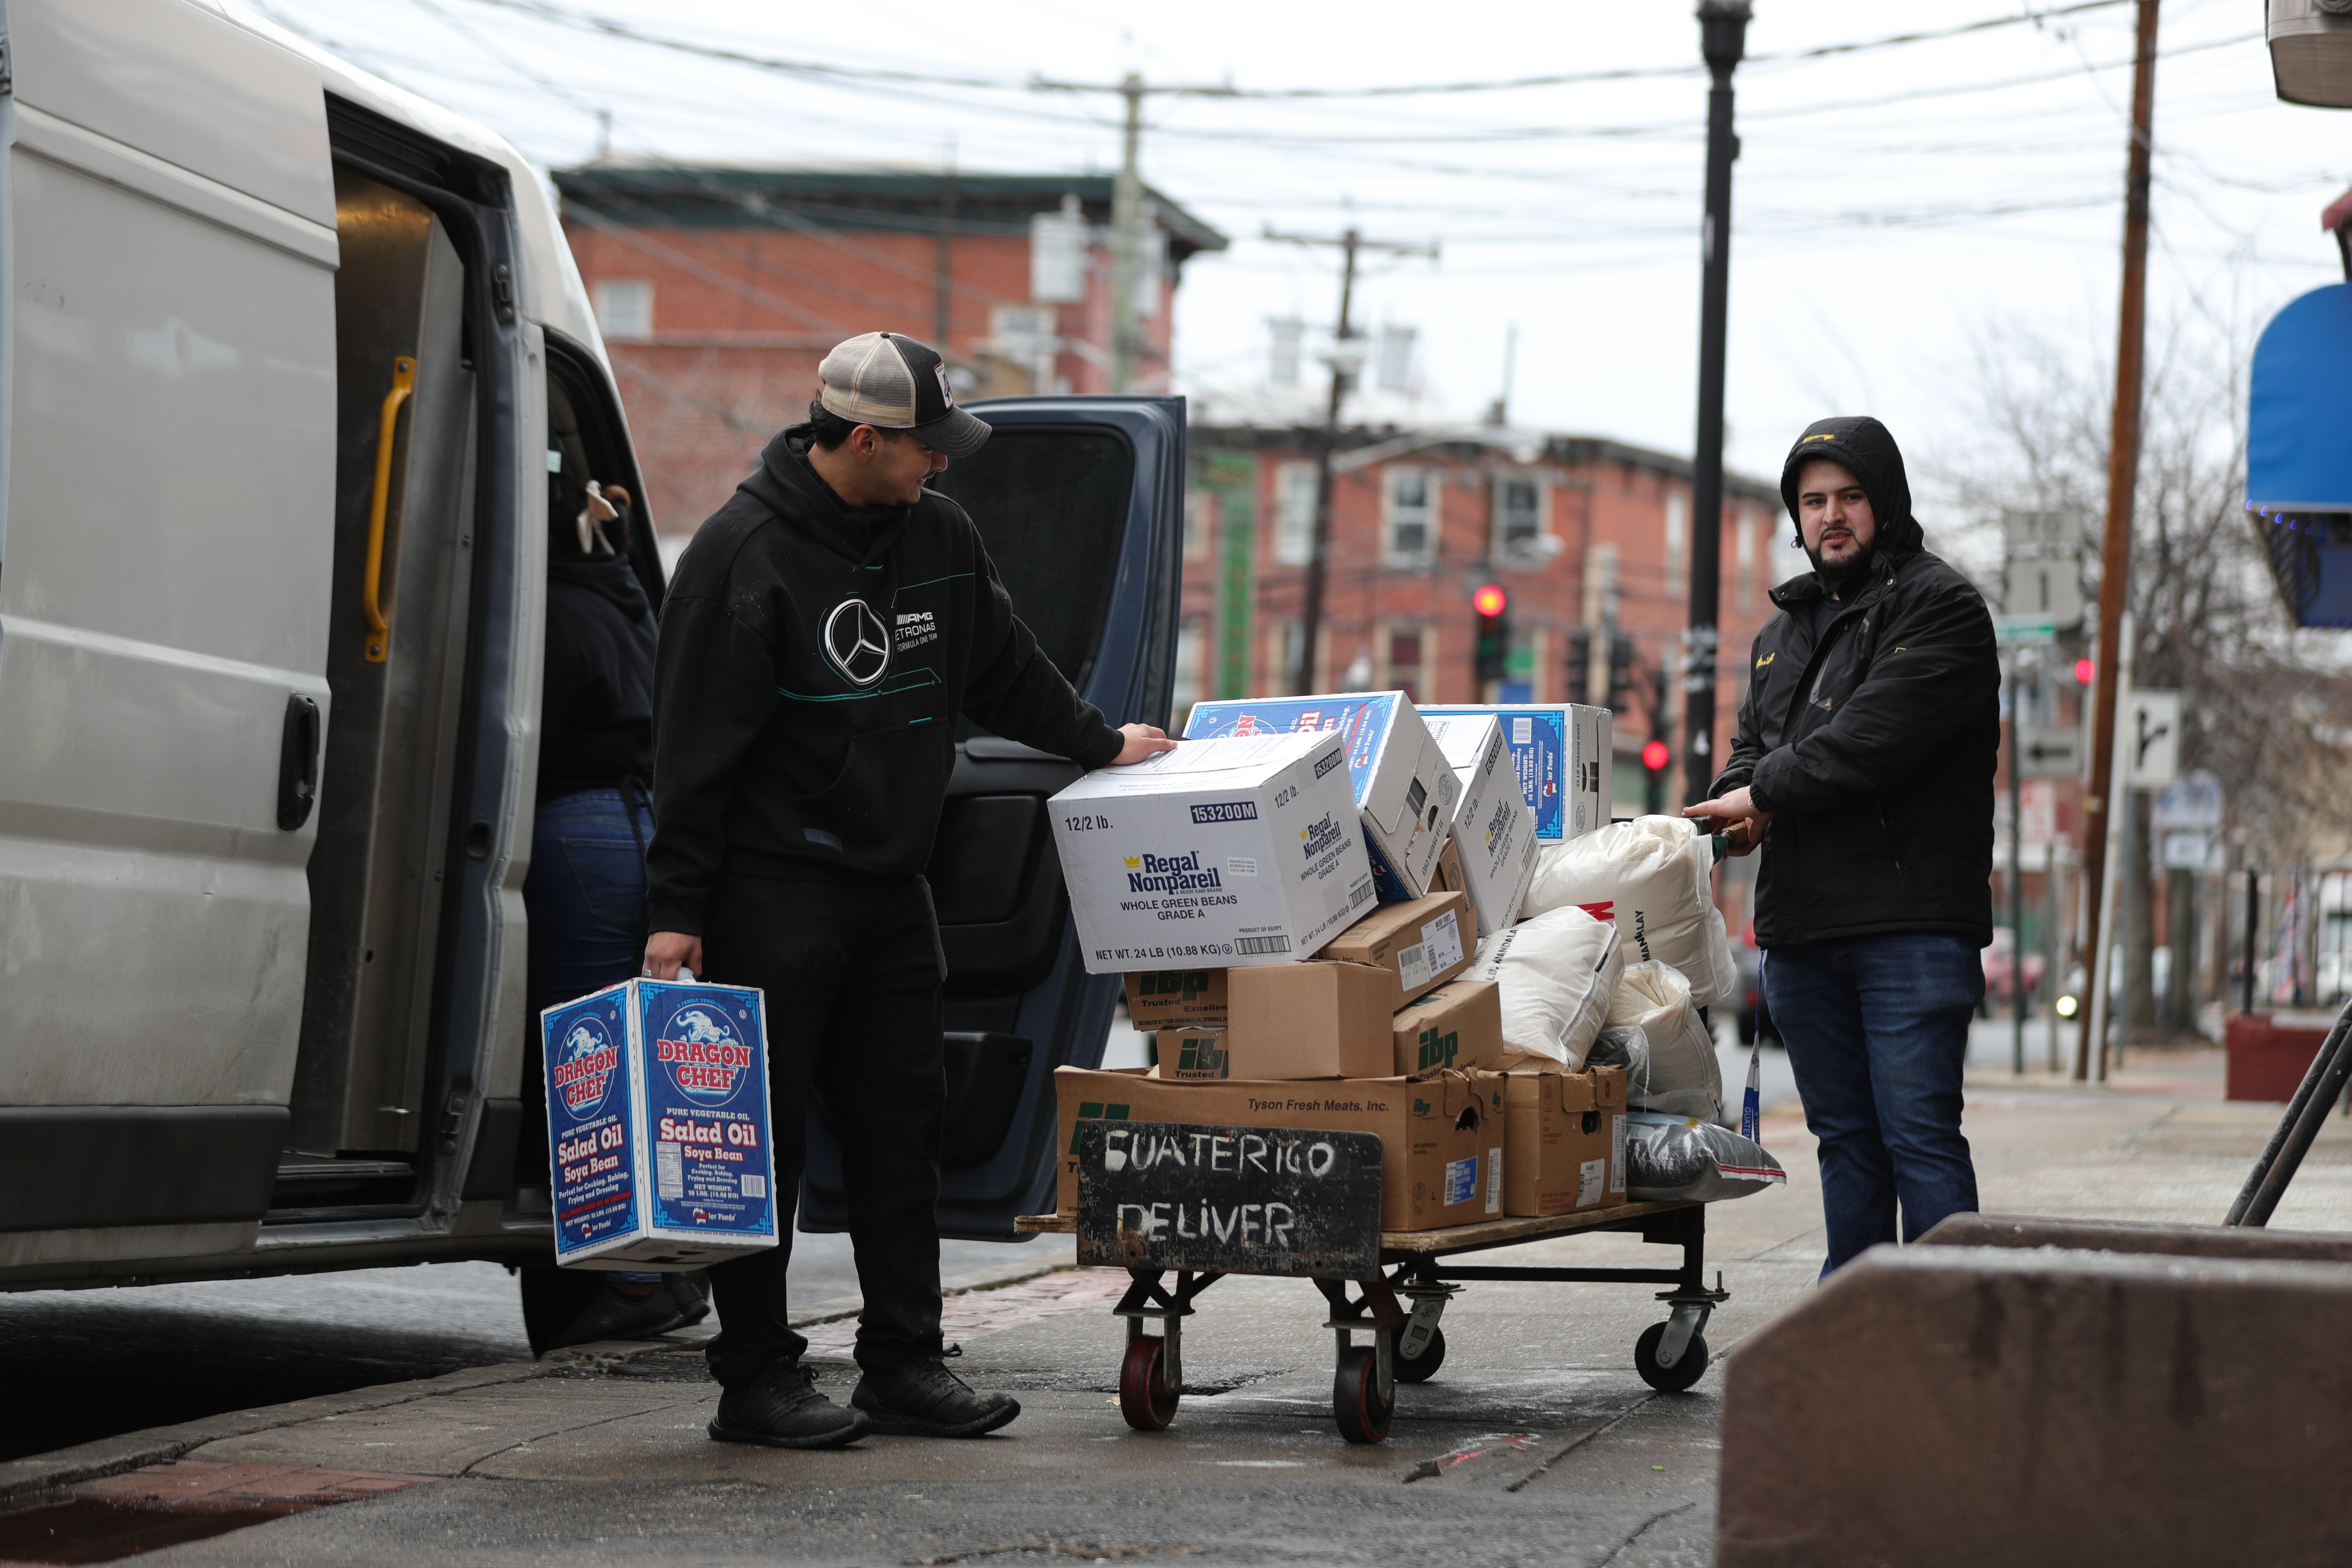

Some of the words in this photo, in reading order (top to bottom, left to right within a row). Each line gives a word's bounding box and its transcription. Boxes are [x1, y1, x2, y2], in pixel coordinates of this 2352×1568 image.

[907, 612, 933, 624] AMG
[895, 622, 936, 642] ETRONAS
[897, 639, 920, 652] FORMULA
[920, 635, 928, 644] ONE
[928, 632, 937, 640] TEAM
[1290, 718, 1298, 730] OIL
[1315, 750, 1342, 777] 153200M
[1486, 734, 1503, 774] 153200M
[1577, 770, 1580, 778] LB
[1274, 789, 1289, 809] 12/2
[1289, 784, 1299, 799] lb.
[1065, 816, 1093, 832] 12/2
[1096, 815, 1113, 829] lb.
[1192, 802, 1256, 823] 153200M
[1464, 806, 1473, 830] 12/2
[1488, 798, 1504, 836] Regal
[1307, 812, 1332, 841] Regal
[1488, 801, 1511, 858] Nonpareil
[1303, 821, 1341, 860] Nonpareil
[1430, 835, 1439, 858] DRAGON
[1489, 856, 1500, 879] WHOLE
[1499, 832, 1510, 856] GREEN
[1508, 809, 1518, 833] BEANS
[1142, 851, 1200, 876] Regal
[1300, 863, 1319, 881] WHOLE
[1319, 850, 1335, 868] GREEN
[1335, 839, 1352, 857] BEANS
[1422, 856, 1431, 877] CHEF
[1500, 845, 1511, 867] GRADE
[1127, 867, 1222, 895] Nonpareil
[1318, 863, 1335, 880] GRADE
[1120, 900, 1159, 911] WHOLE
[1161, 897, 1198, 908] GREEN
[1200, 895, 1238, 906] BEANS
[1158, 910, 1195, 920] GRADE
[1198, 909, 1206, 918] A
[1308, 931, 1316, 942] WT.
[1315, 927, 1320, 936] 24
[1320, 923, 1326, 933] LB
[1337, 907, 1346, 919] KG)
[1443, 914, 1451, 923] FEET
[1096, 949, 1113, 960] NET
[1115, 949, 1133, 959] WT.
[1134, 948, 1147, 959] 24
[1149, 947, 1164, 958] LB
[1167, 946, 1198, 959] (10.88
[1201, 944, 1222, 956] KG)
[1485, 966, 1499, 982] LB.
[681, 998, 699, 1007] FAMILY
[700, 998, 727, 1012] TRADITION
[1141, 998, 1181, 1007] Trusted
[570, 1014, 582, 1026] FAMILY
[657, 1039, 750, 1068] DRAGON
[1178, 1038, 1229, 1078] ib
[1418, 1026, 1458, 1071] ibp
[554, 1044, 617, 1089] DRAGON
[677, 1065, 735, 1090] CHEF
[1420, 1064, 1444, 1079] Trusted
[1458, 1058, 1476, 1071] ellence
[567, 1074, 606, 1107] CHEF
[667, 1107, 688, 1115] PURE
[690, 1109, 735, 1120] VEGETABLE
[1248, 1098, 1283, 1111] Tyson
[1286, 1099, 1320, 1111] Fresh
[1324, 1099, 1363, 1112] Meats,
[1367, 1100, 1389, 1111] Inc.
[1413, 1098, 1430, 1115] ibp
[561, 1128, 575, 1139] PURE
[576, 1118, 606, 1134] VEGETABLE
[608, 1114, 618, 1123] OIL
[660, 1118, 723, 1144] Salad
[727, 1122, 757, 1146] Oil
[1743, 1107, 1752, 1137] GUATE
[558, 1131, 598, 1166] Salad
[601, 1123, 623, 1150] Oil
[684, 1145, 712, 1161] Soya
[714, 1147, 743, 1161] Bean
[564, 1165, 588, 1183] Soya
[590, 1155, 619, 1174] Bean
[559, 1190, 576, 1199] Perfect
[584, 1178, 606, 1190] Cooking,
[607, 1171, 629, 1182] Baking,
[717, 1176, 737, 1185] Dressing
[568, 1195, 585, 1205] Frying
[585, 1190, 595, 1198] and
[596, 1183, 619, 1195] Dressing
[598, 1221, 611, 1230] Foods
[718, 1213, 735, 1221] Foods
